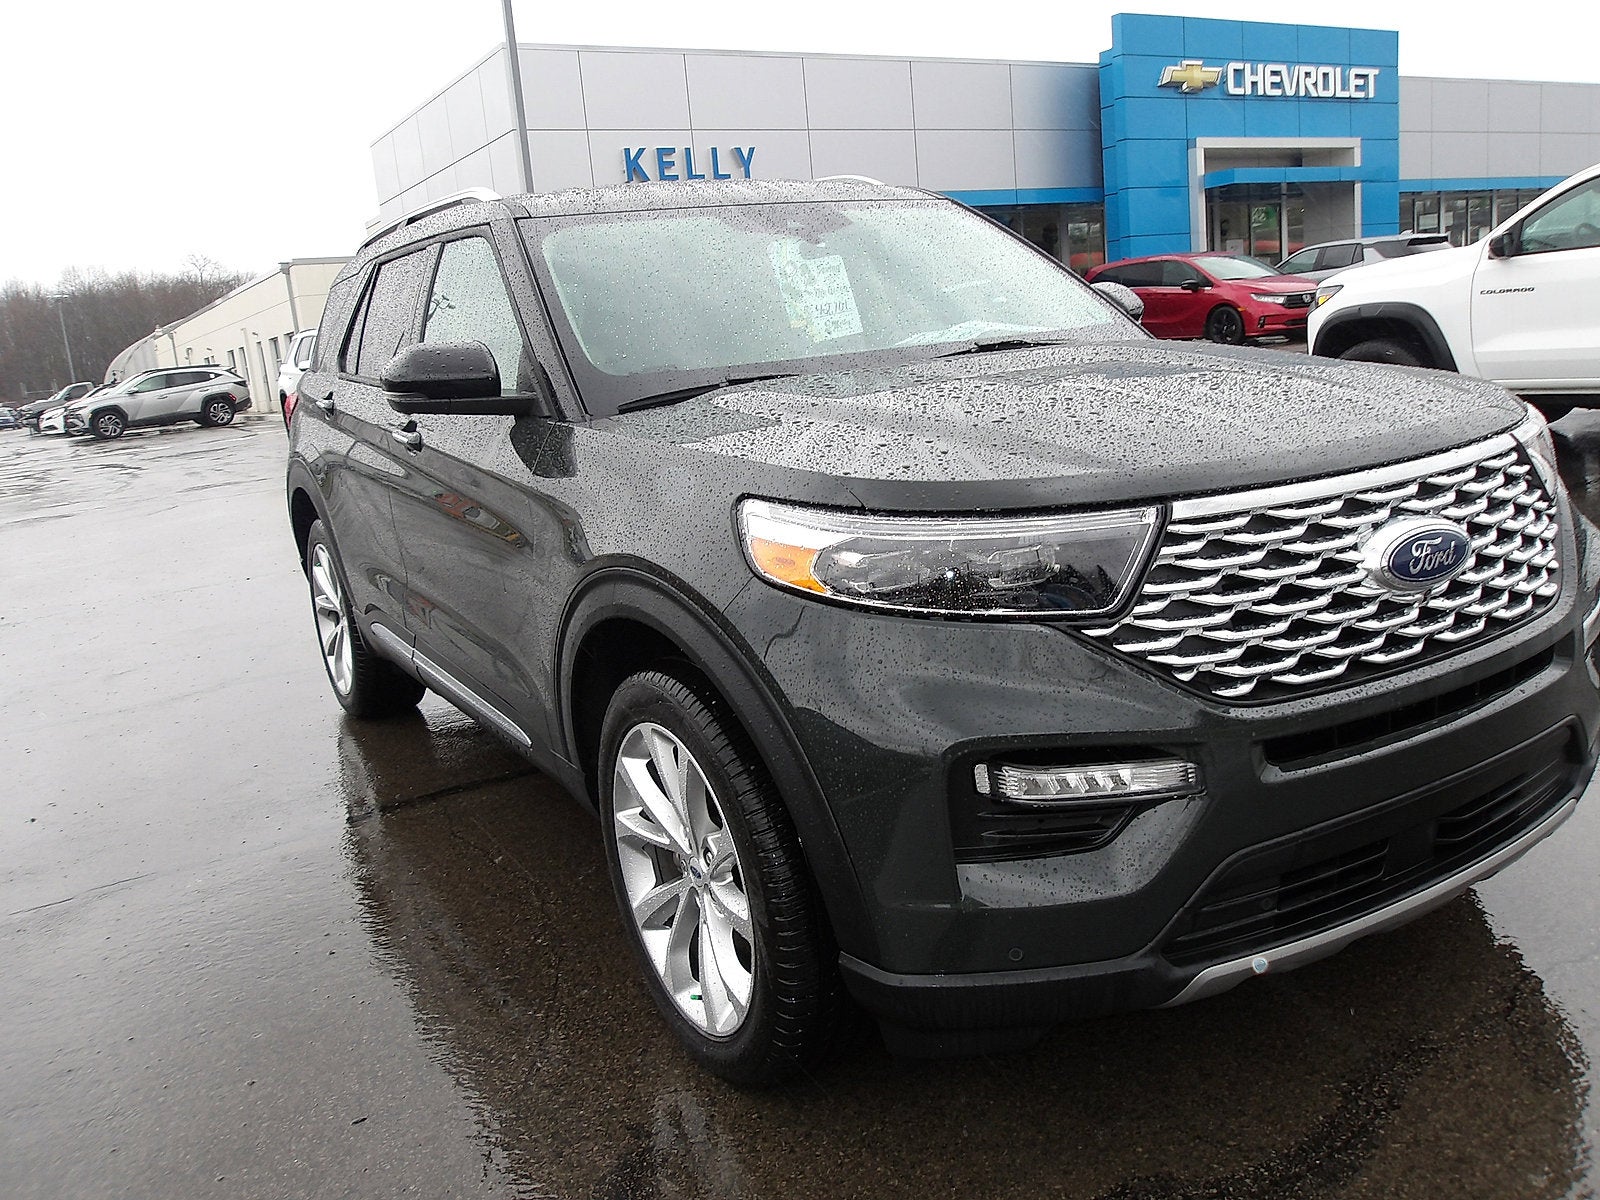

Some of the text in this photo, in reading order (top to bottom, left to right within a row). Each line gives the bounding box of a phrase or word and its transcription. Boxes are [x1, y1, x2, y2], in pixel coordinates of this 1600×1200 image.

[1226, 62, 1379, 98] CHEVROLET
[622, 147, 756, 182] KELLY
[1480, 286, 1535, 295] COLORADO
[1409, 536, 1456, 575] Ford
